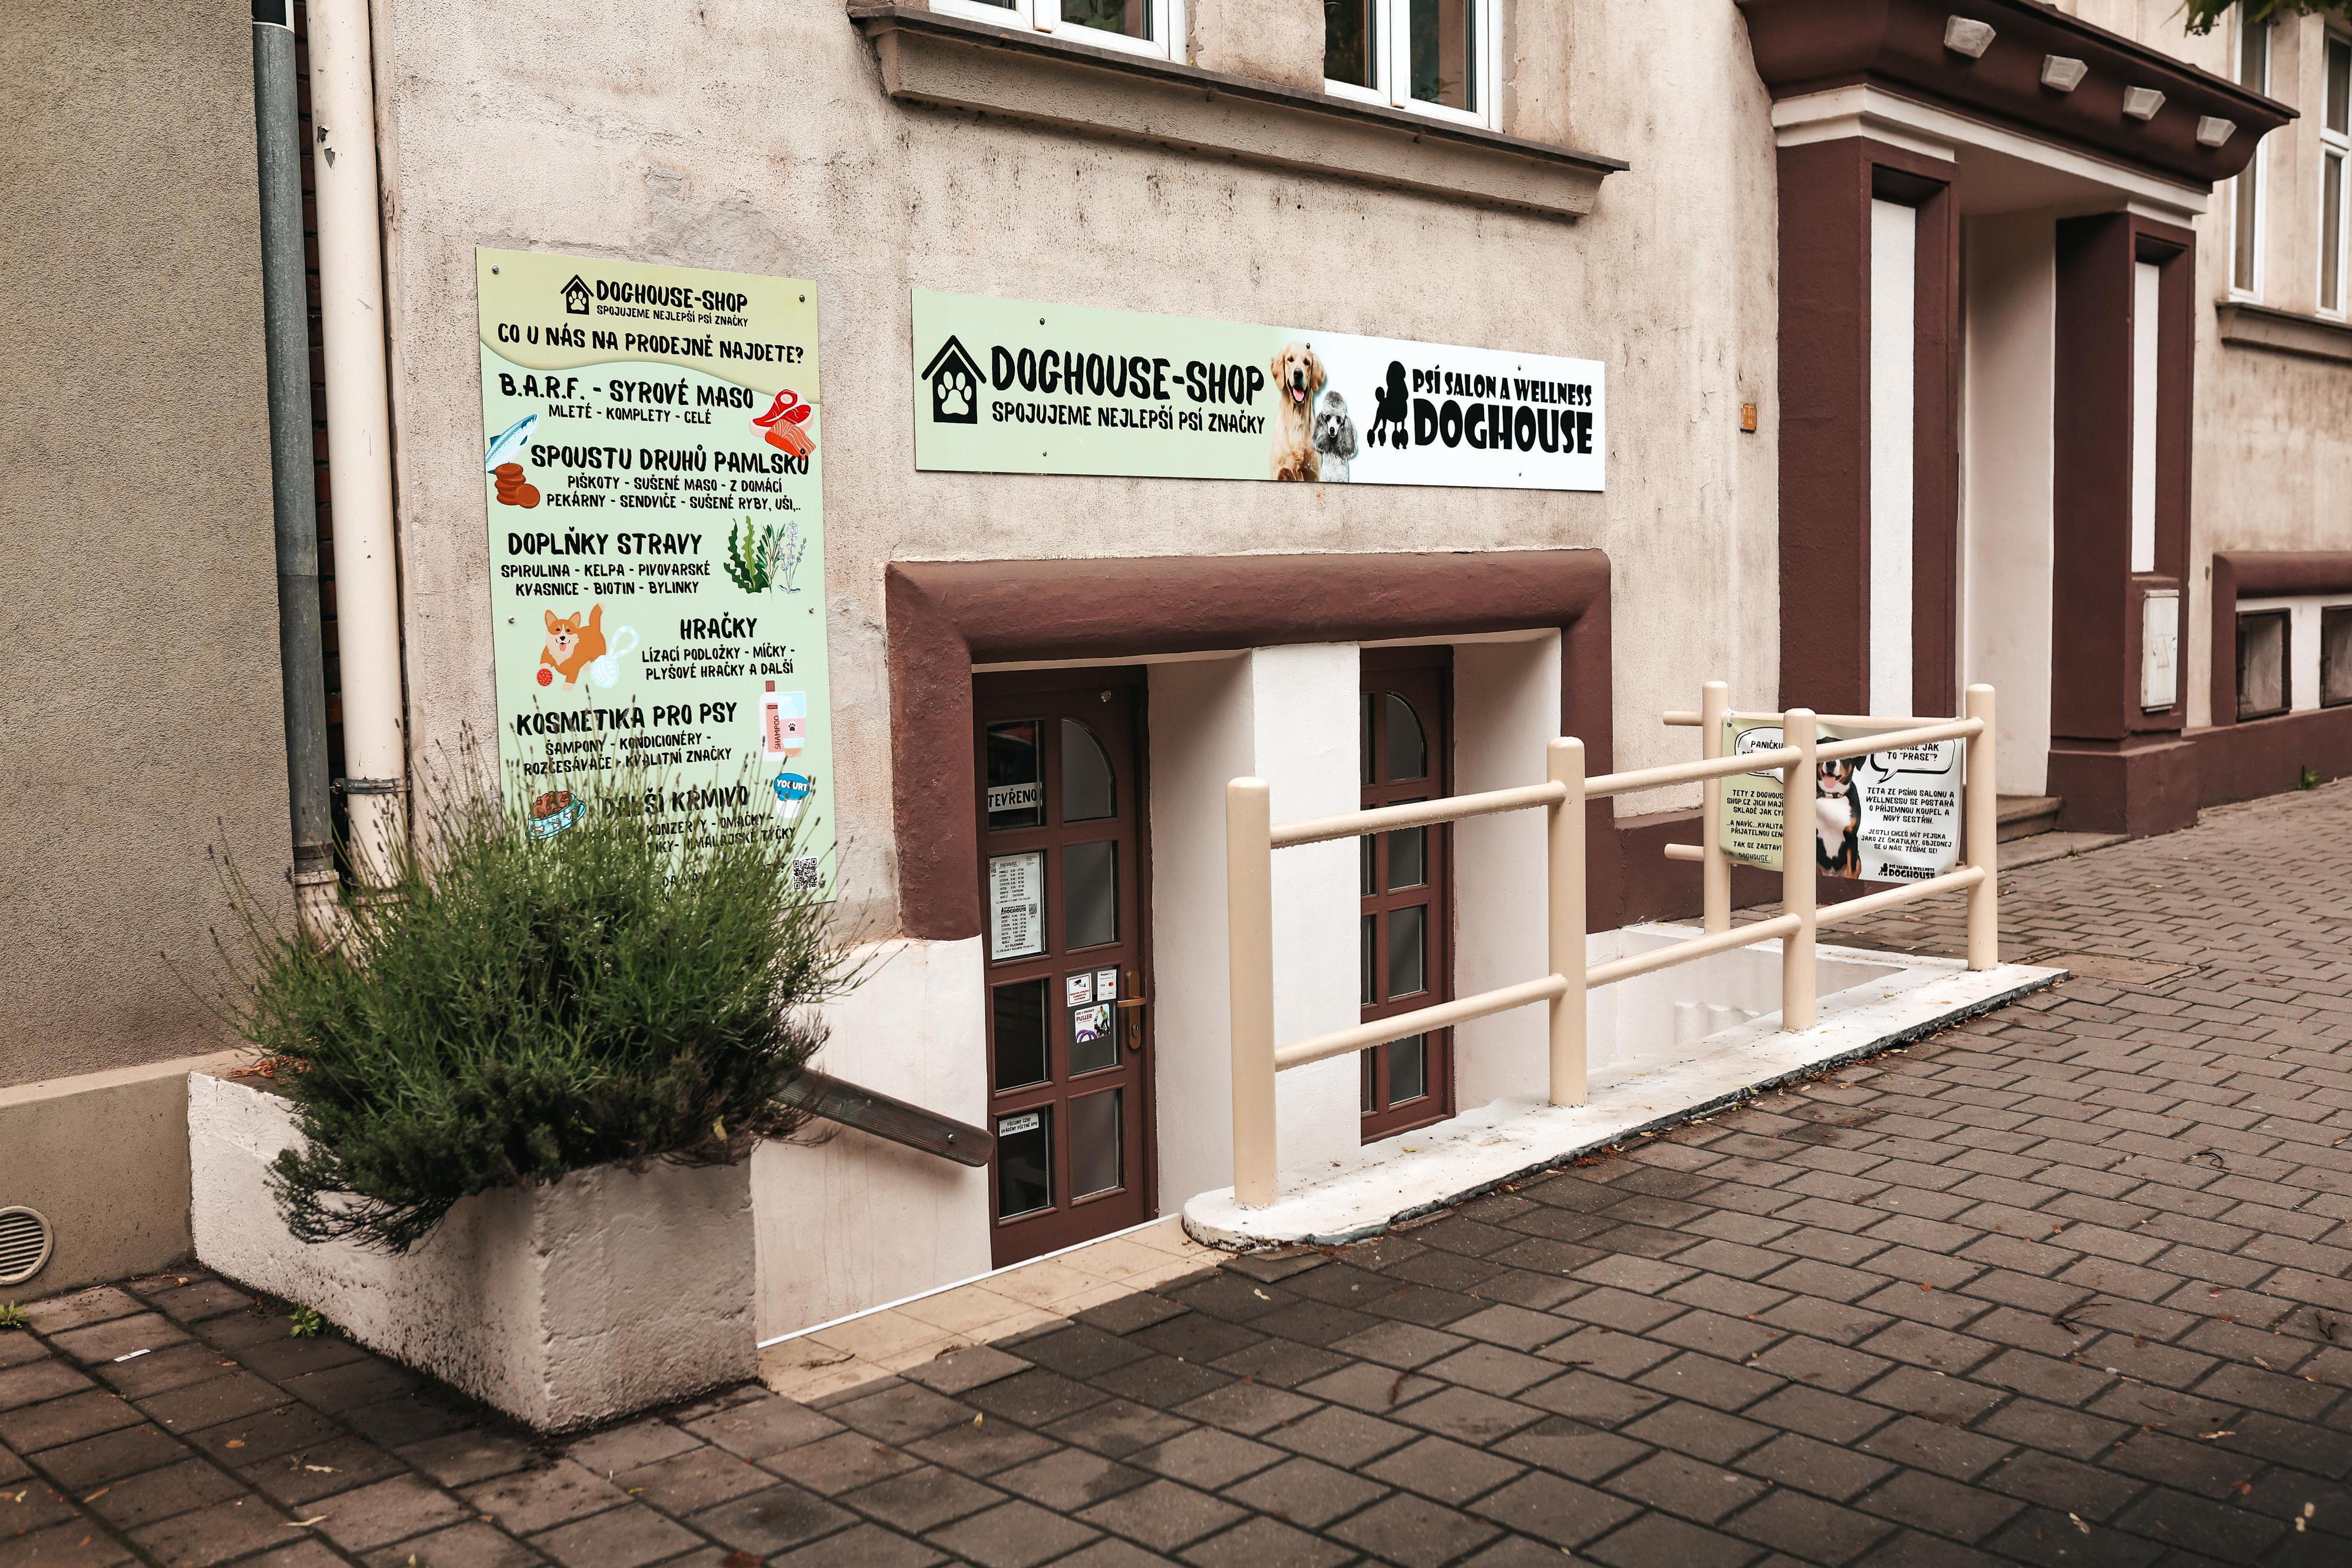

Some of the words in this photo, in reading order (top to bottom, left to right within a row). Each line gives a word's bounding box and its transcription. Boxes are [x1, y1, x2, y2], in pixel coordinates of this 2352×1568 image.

[596, 280, 747, 315] DOGHOUSE-SHOP
[597, 305, 650, 319] SPOJUJEME
[653, 310, 695, 322] NEJLEPŠÍ
[698, 312, 712, 324] PSÍ
[715, 315, 748, 327] ZNAČKY
[498, 323, 520, 343] CO
[527, 326, 539, 345] U
[546, 322, 585, 348] NÁS
[592, 331, 618, 351] NA
[625, 333, 713, 357] PRODEJNĚ
[720, 341, 803, 364] NAJDETE?
[991, 345, 1264, 409] DOGHOUSE-SHOP
[1413, 364, 1440, 394] PSÍ
[1444, 372, 1496, 398] SALON
[1500, 377, 1510, 400] A
[1513, 378, 1592, 407] WELLNESS
[499, 373, 585, 400] B.A.R.F.
[609, 377, 689, 405] SYROVÉ
[697, 385, 753, 408] MASO
[549, 402, 592, 419] MLETÉ
[606, 407, 671, 422] KOMPLETY
[684, 408, 711, 424] CELÉ
[992, 401, 1091, 425] SPOJUJEME
[1098, 404, 1173, 430] NEJLEPŠÍ
[1179, 407, 1203, 431] PSÍ
[1208, 410, 1265, 434] ZNAČKY
[1413, 395, 1592, 454] DOGHOUSE
[531, 445, 632, 470] SPOUSTU
[639, 444, 707, 472] DRUHŮ
[568, 476, 620, 489] PIŠKOTY
[634, 474, 680, 490] SUŠENÉ
[684, 478, 717, 491] MASO
[730, 480, 737, 491] Z
[741, 477, 782, 493] DOMÁCÍ
[547, 490, 606, 507] PEKÁRNY
[620, 492, 677, 508] SENDVIČE
[690, 493, 734, 509] SUŠENÉ
[738, 497, 771, 511] RYBY,
[508, 526, 609, 555] DOPLŇKY
[617, 533, 702, 554] STRAVY
[501, 564, 570, 577] SPIRULINA
[585, 564, 625, 577] KELPA
[638, 560, 710, 576] PIVOVARSKÉ
[516, 583, 579, 596] KVASNICE
[593, 582, 635, 595] BIOTIN
[648, 581, 699, 594] BYLINKY
[680, 612, 757, 640] HRAČKY
[642, 646, 679, 663] LÍZACÍ
[684, 644, 740, 661] PODLOŽKY
[753, 642, 786, 658] MÍČKY
[646, 662, 697, 681] PLYŠOVÉ
[701, 661, 745, 678] HRAČKY
[749, 663, 757, 675] A
[761, 658, 793, 675] DALŠÍ
[516, 707, 645, 737] KOSMETIKA
[652, 704, 692, 727] PRO
[699, 702, 737, 724] PSY
[545, 737, 606, 755] ŠAMPONY
[619, 732, 703, 751] KONDICIONÉRY
[1922, 743, 1939, 751] JAK
[523, 754, 612, 776] ROZČESÁVAČE
[625, 750, 682, 767] KVALITNÍ
[686, 748, 731, 762] ZNAČKY
[1899, 752, 1938, 761] "PRASE"?
[672, 785, 749, 813] KRMIVO
[1733, 806, 1757, 814] SKLADĚ
[1875, 804, 1914, 814] PŘÍJEMNOU
[1921, 798, 1954, 807] POSTARÁ
[646, 819, 707, 836] KONZERY
[721, 811, 765, 829] OMAČKY
[1902, 815, 1934, 824] SESTŘIH.
[761, 825, 796, 842] TYČKY
[1731, 826, 1770, 837] PŘIJATELNOU
[1887, 837, 1921, 846] ŠKATULKY,
[1756, 843, 1782, 851] ZASTAV!
[1888, 869, 1935, 879] DOGHOUSE
